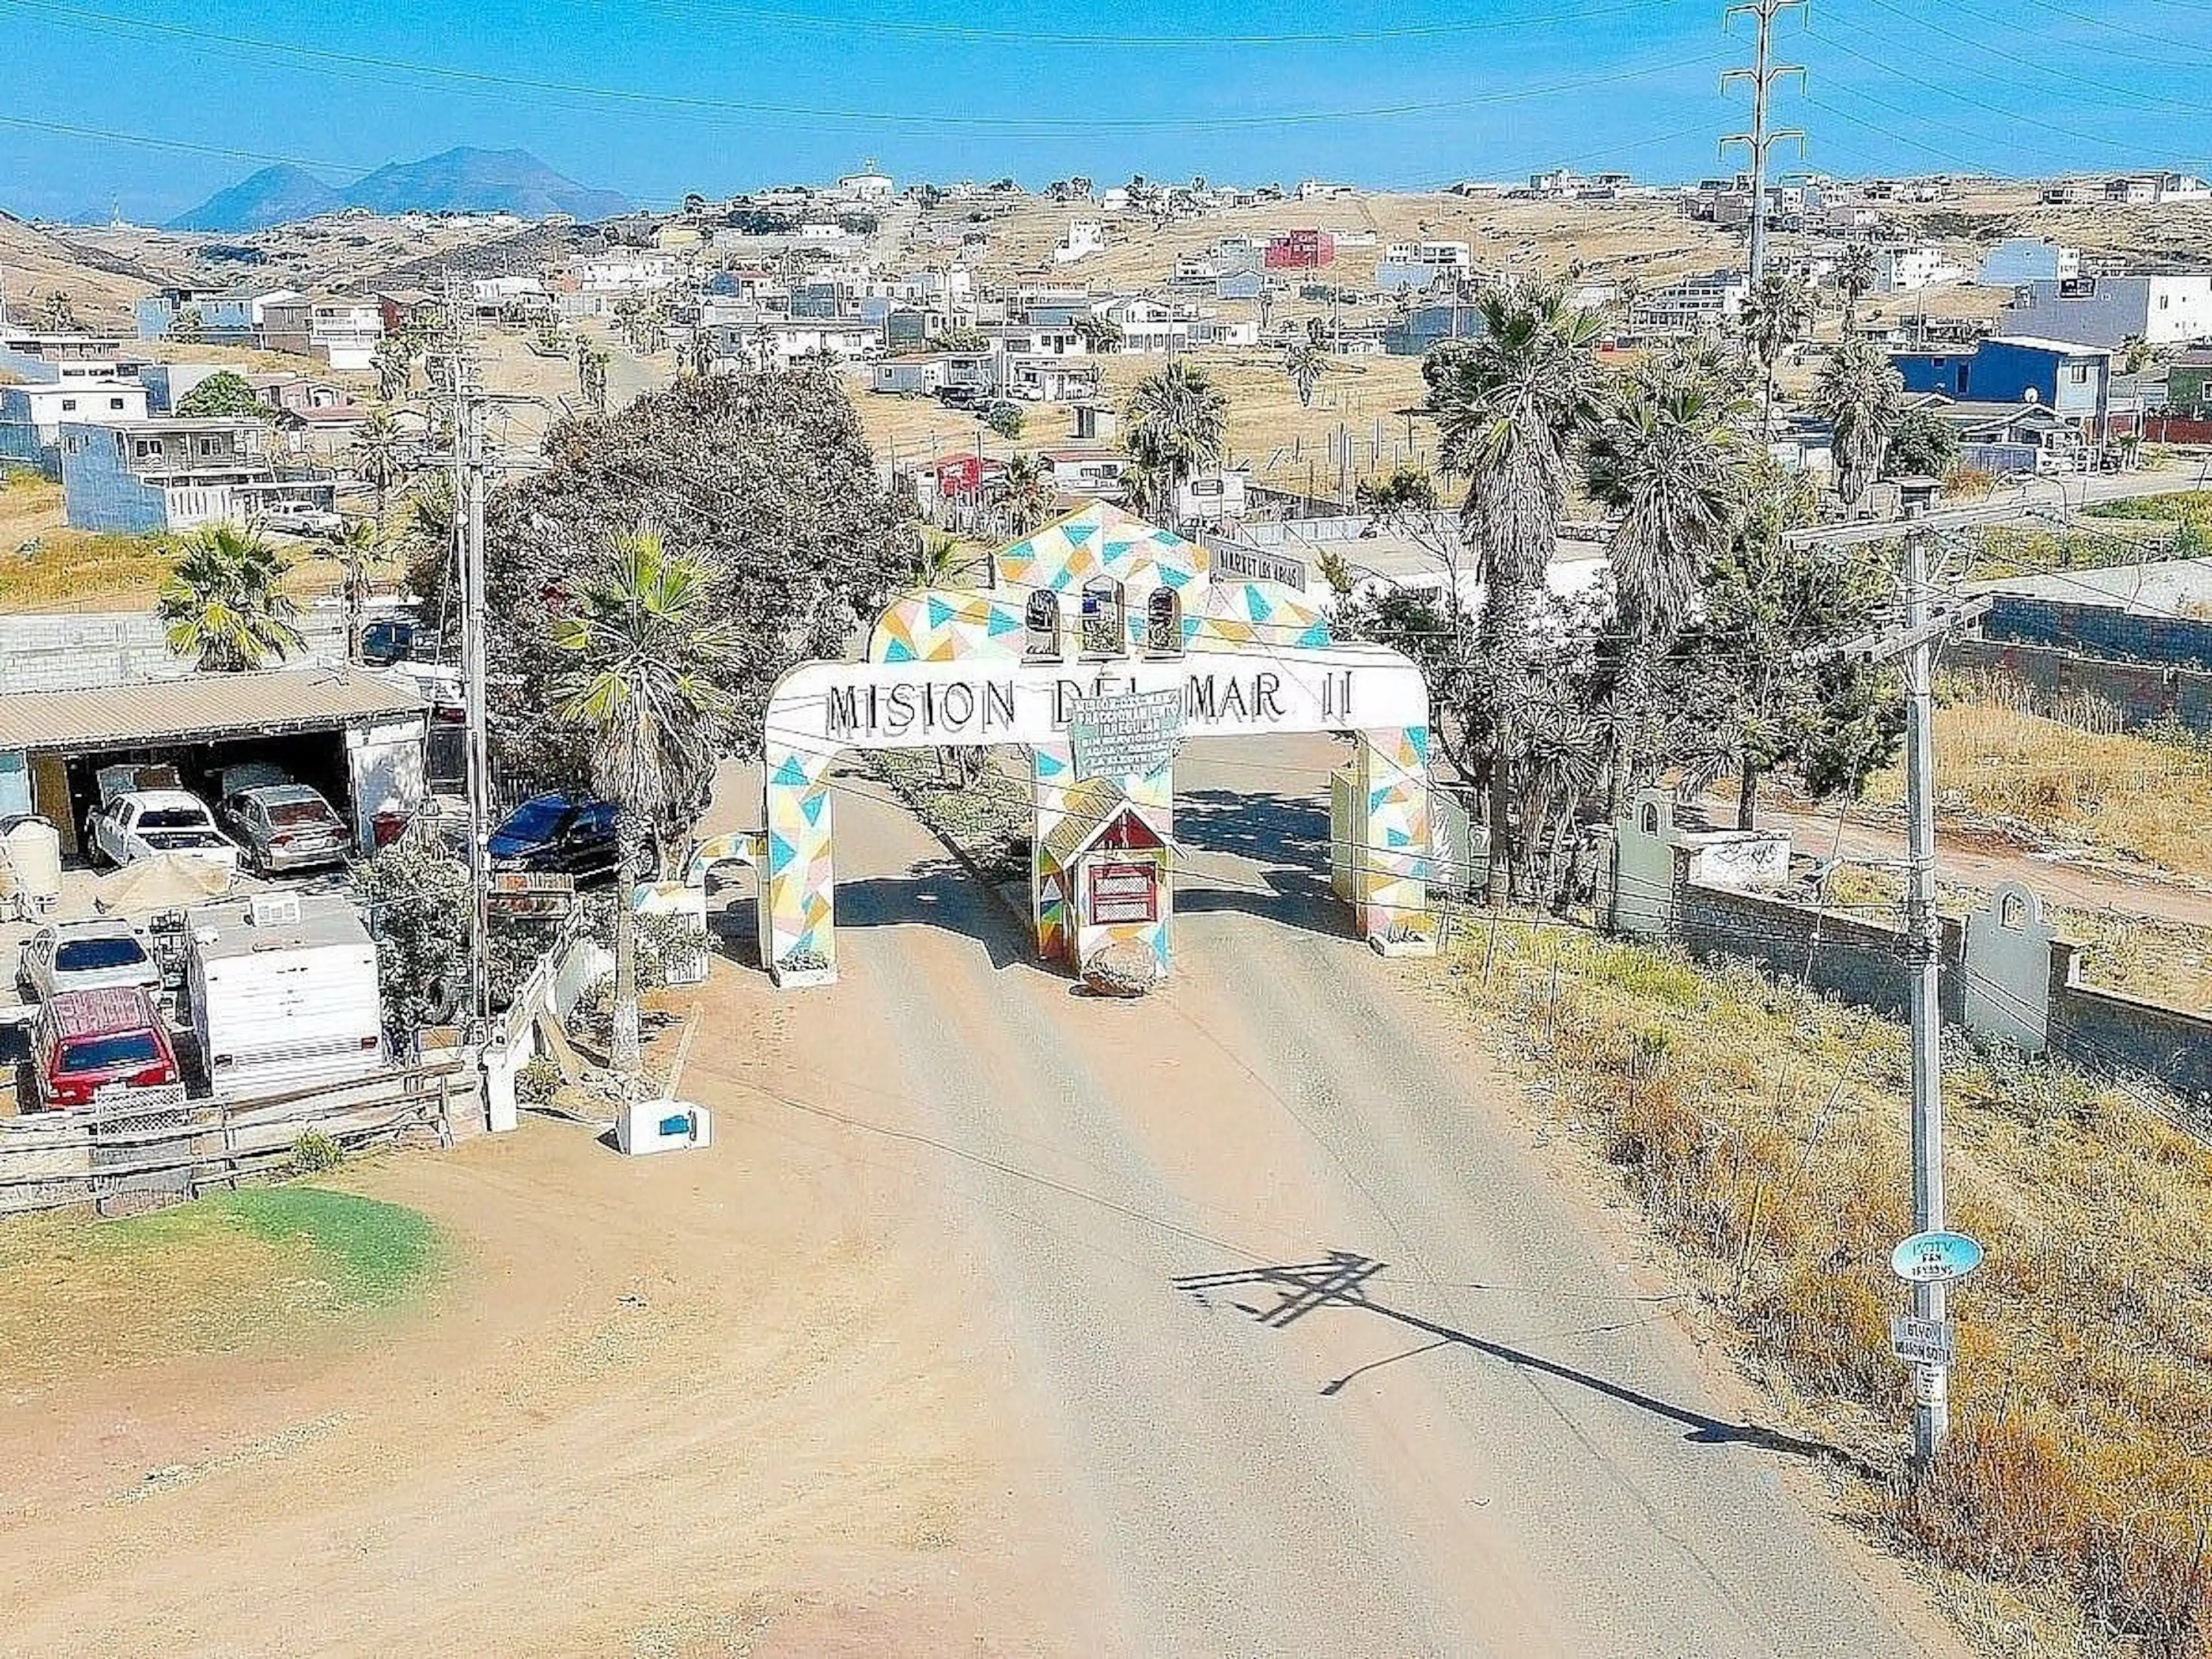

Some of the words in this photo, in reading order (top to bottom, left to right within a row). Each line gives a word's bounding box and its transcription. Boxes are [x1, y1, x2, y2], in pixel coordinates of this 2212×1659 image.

[828, 679, 1014, 732] MISION
[1188, 672, 1287, 718] MAR
[1325, 671, 1352, 715] II
[1100, 719, 1161, 737] IRREGULAR
